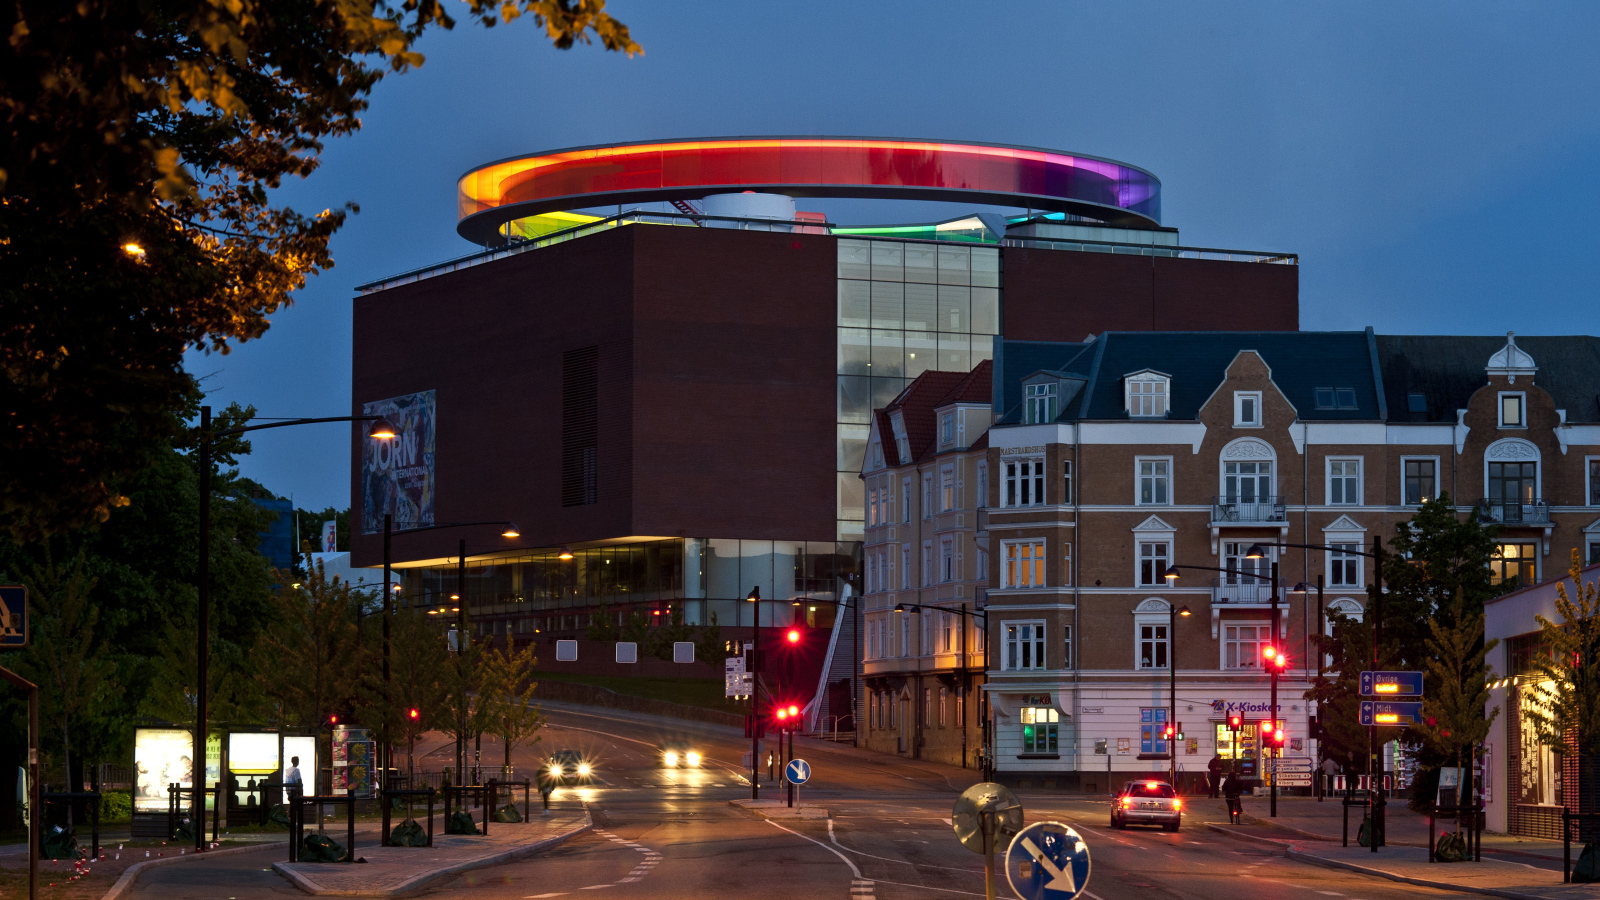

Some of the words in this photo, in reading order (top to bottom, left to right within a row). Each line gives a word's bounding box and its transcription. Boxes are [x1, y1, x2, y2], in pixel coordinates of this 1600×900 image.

[369, 432, 416, 472] JORN
[1376, 674, 1398, 683] Øvrige
[1376, 704, 1392, 713] Midt
